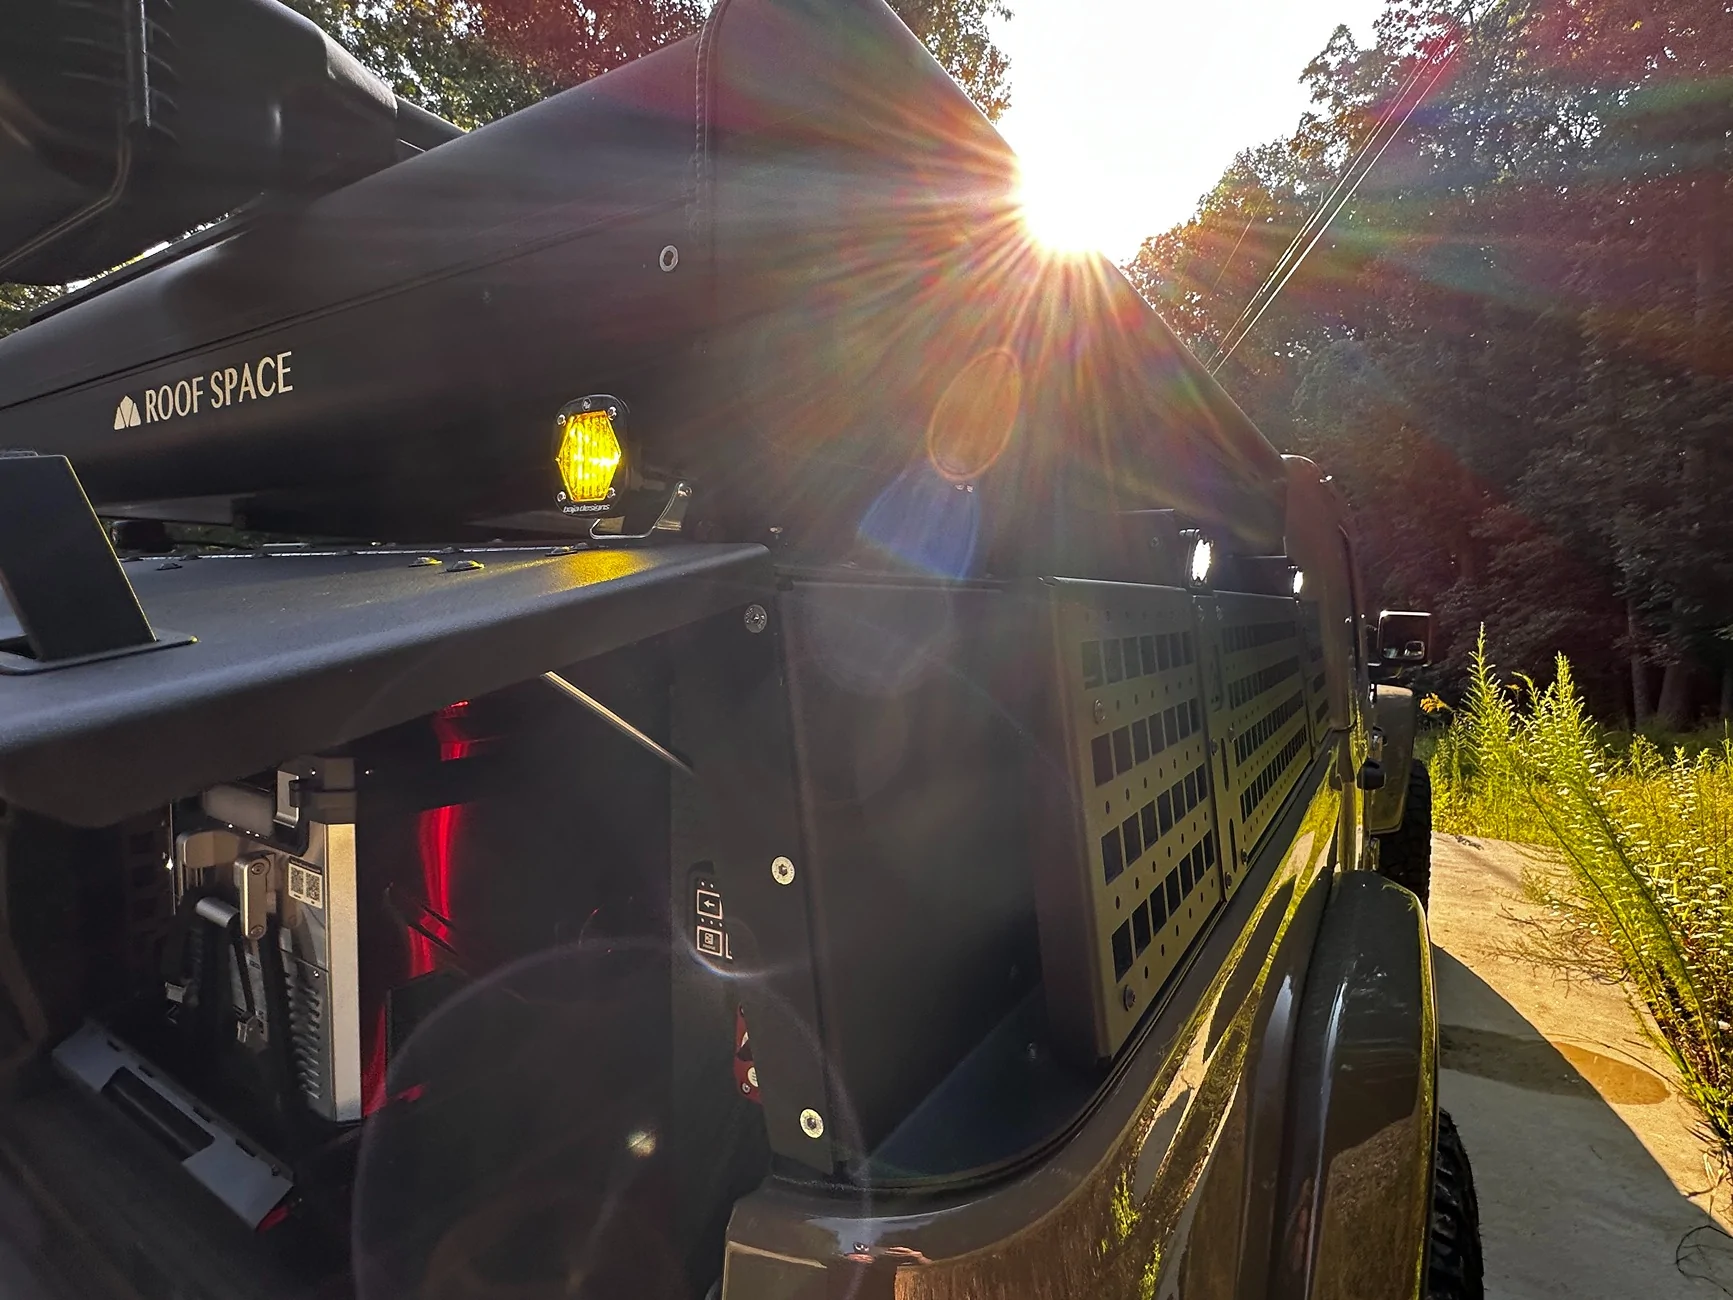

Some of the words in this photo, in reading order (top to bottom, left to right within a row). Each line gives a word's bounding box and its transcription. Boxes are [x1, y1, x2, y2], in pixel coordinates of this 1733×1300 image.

[145, 376, 204, 424] ROOF
[210, 351, 294, 409] SPACE
[563, 505, 579, 514] baja
[580, 504, 610, 512] designs
